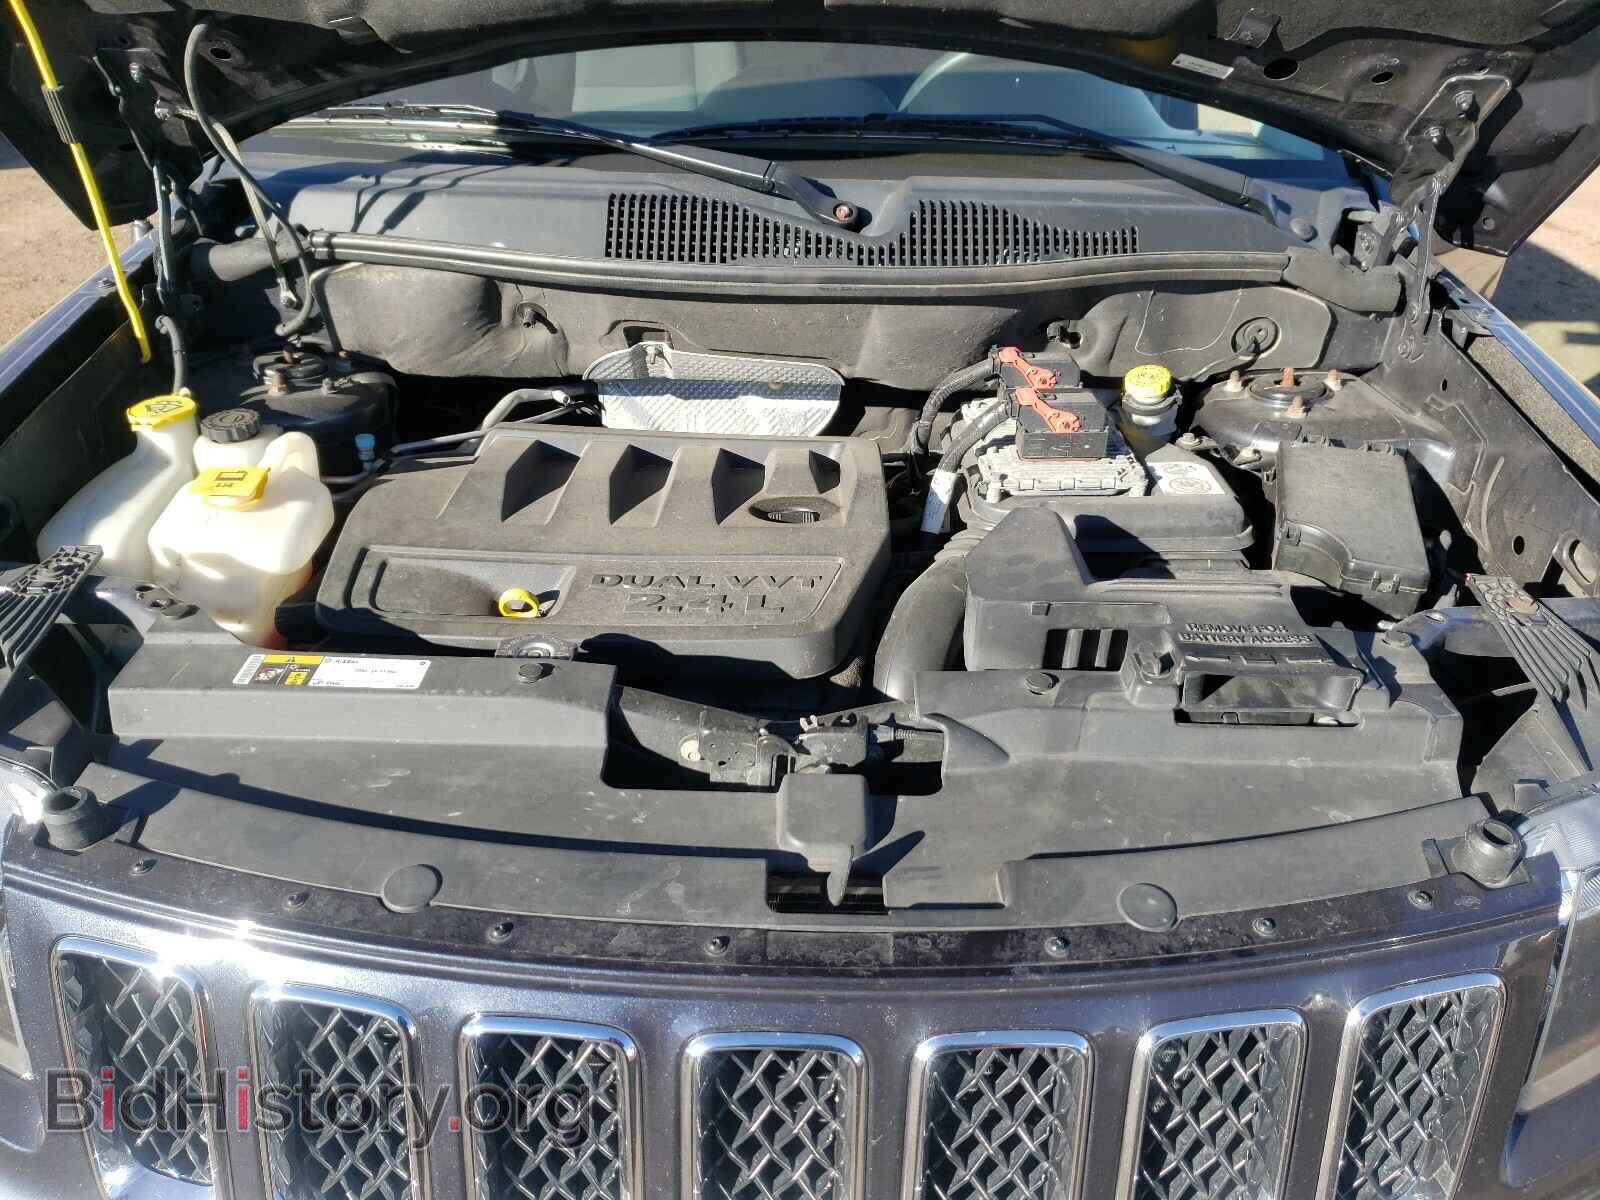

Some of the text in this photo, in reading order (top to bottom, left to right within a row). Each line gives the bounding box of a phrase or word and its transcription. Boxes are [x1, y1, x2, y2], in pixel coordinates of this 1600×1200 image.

[591, 573, 824, 590] DUAL VVT
[1184, 622, 1290, 634] REMOVE FOR
[1178, 633, 1314, 644] BATTERY ACCESS
